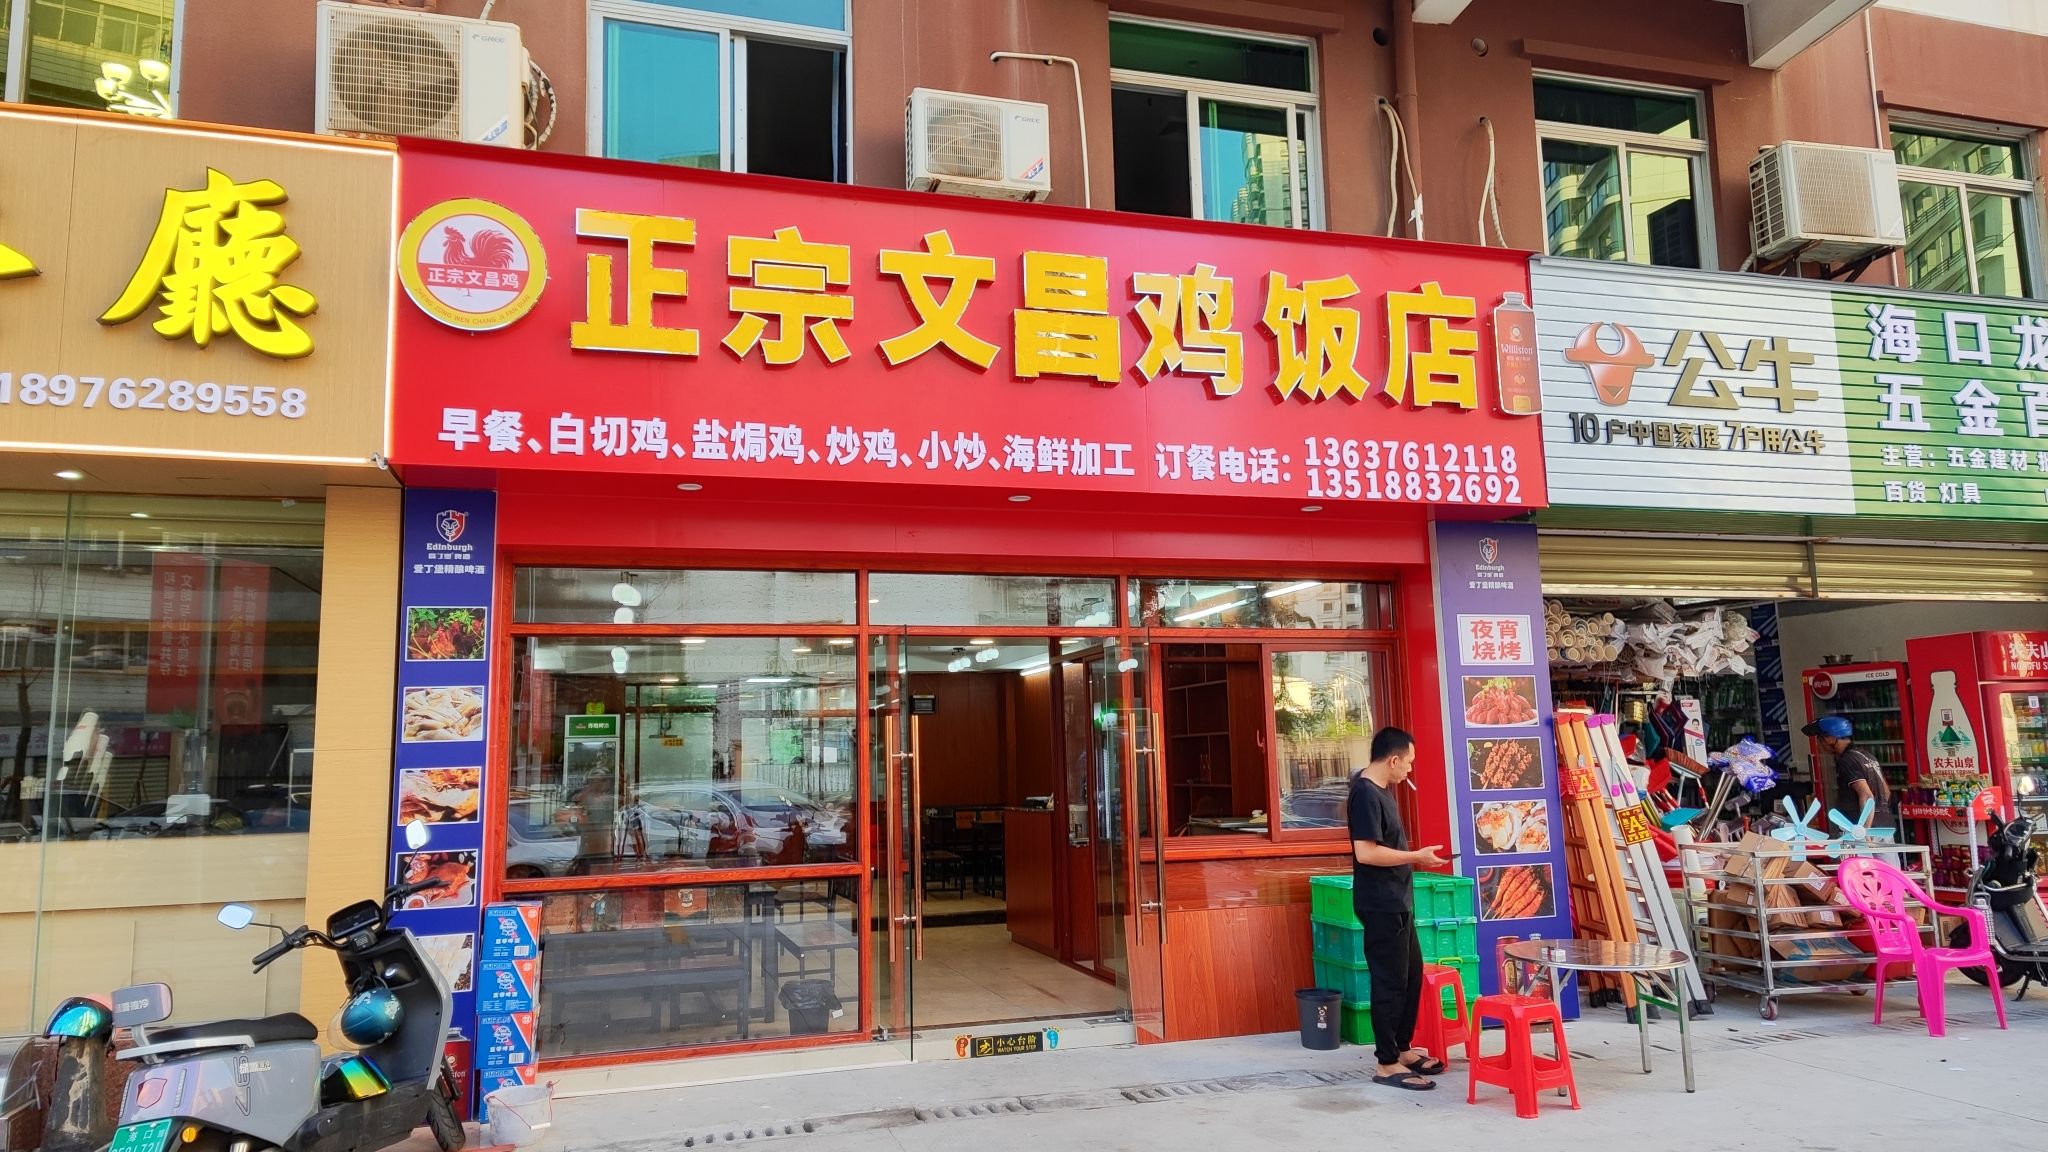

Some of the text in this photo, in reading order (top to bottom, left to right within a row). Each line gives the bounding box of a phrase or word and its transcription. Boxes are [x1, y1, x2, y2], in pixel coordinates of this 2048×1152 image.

[0, 166, 318, 359] 廳
[428, 267, 519, 289] 正宗文昌鸡
[570, 208, 1480, 414] 正宗文昌鸡饭店
[1663, 329, 1819, 413] 公牛
[0, 372, 307, 418] 18976289558
[1155, 442, 1292, 484] 订餐电话：
[1304, 436, 1517, 474] 13637612118
[1306, 467, 1522, 503] 13518832692
[1883, 480, 1981, 504] 百货 灯具
[426, 543, 473, 552] Edinburgh
[1475, 564, 1504, 572] Edinburgh
[1470, 620, 1519, 639] 夜宵
[1472, 641, 1521, 661] 烧烤
[1933, 757, 1975, 769] 农夫山泉
[1579, 775, 1594, 791] A
[1629, 816, 1646, 833] A
